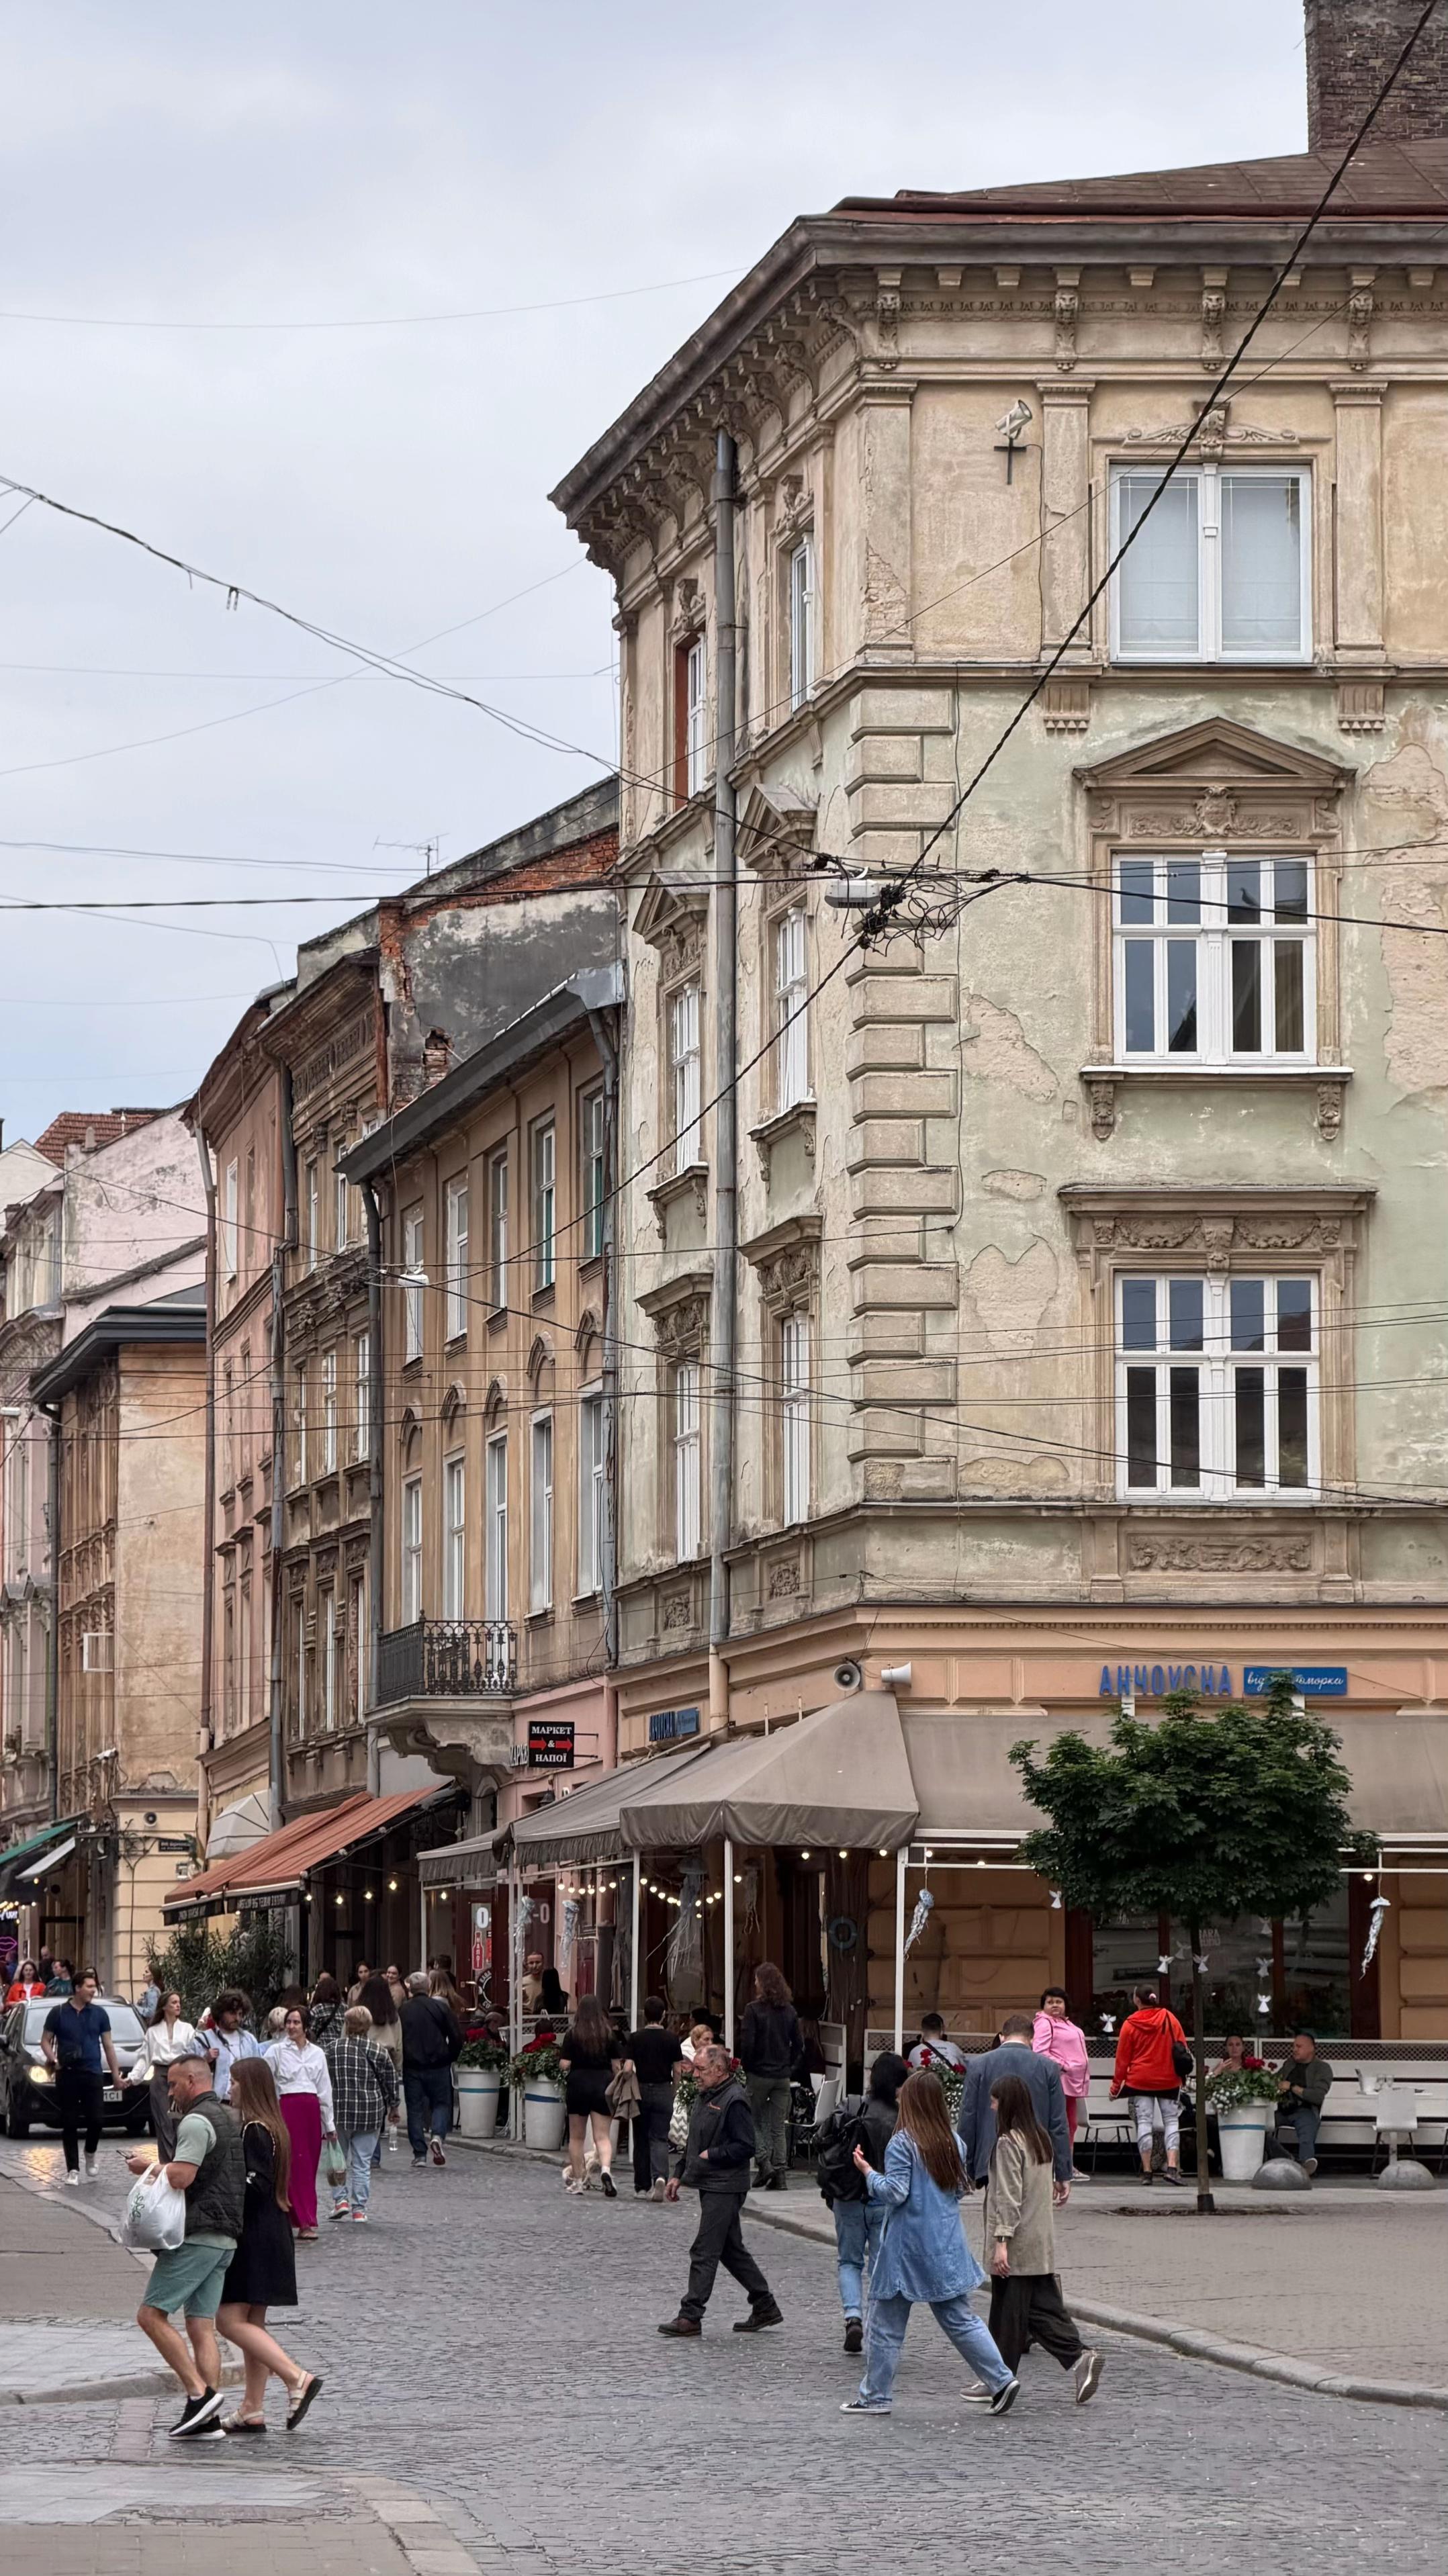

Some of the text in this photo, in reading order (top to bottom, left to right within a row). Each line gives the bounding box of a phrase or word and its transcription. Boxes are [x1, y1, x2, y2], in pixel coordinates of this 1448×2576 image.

[1099, 1665, 1232, 1695] АНЧОУСНА
[531, 1726, 572, 1735] МАРКЕТ
[535, 1753, 567, 1762] НАПОЇ
